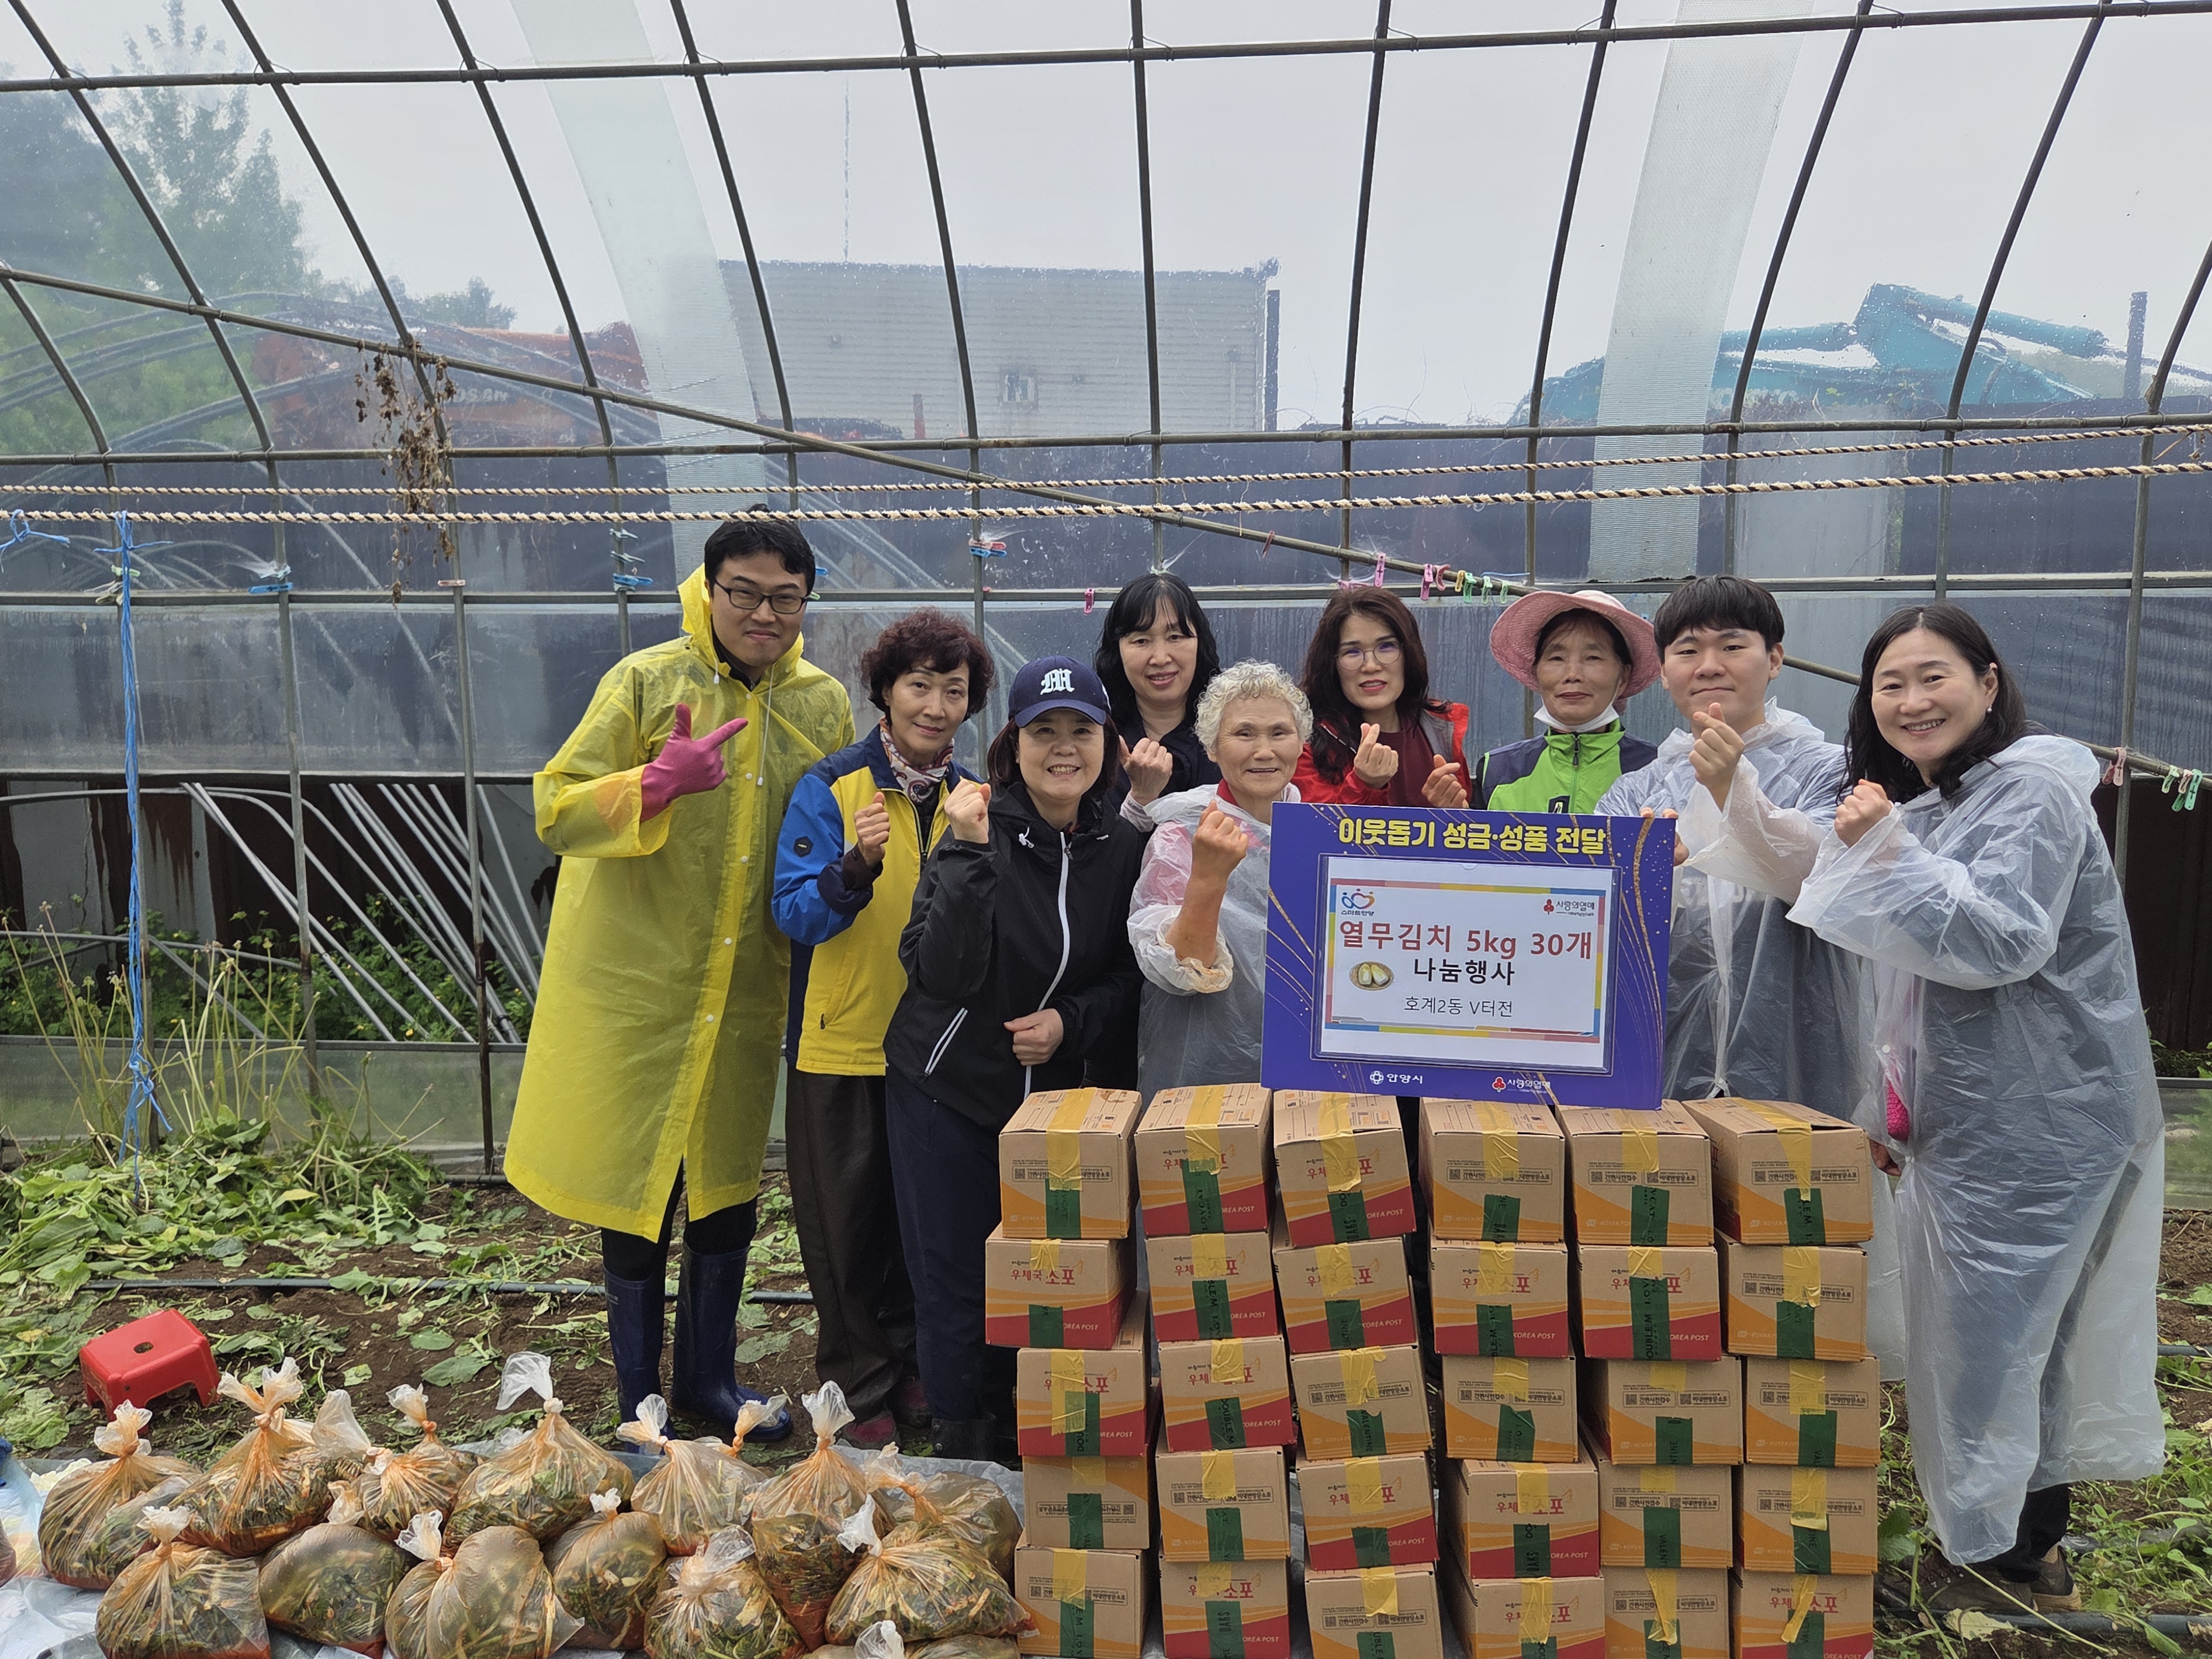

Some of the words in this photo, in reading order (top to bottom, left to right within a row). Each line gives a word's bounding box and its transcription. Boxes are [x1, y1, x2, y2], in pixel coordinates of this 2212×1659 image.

[454, 388, 509, 402] OSAN
[1040, 668, 1074, 695] M
[1339, 818, 1435, 847] 이웃돕기
[1442, 822, 1548, 854] 성금·성품
[1555, 827, 1606, 855] 전달
[1556, 901, 1594, 911] 사랑의열매
[1339, 921, 1451, 952] 열무김치
[1467, 930, 1516, 959] 5kg
[1530, 931, 1592, 960] 30개
[1413, 957, 1515, 986] 나눔행사
[1404, 997, 1463, 1015] 호계2동
[1469, 1001, 1514, 1018] V터전
[1386, 1073, 1423, 1084] 안양시
[1163, 1159, 1182, 1170] 우체
[1367, 1210, 1385, 1219] OREA
[1493, 1223, 1507, 1239] DAK
[1010, 1269, 1042, 1281] 우체국
[1045, 1269, 1075, 1285] 소포
[1611, 1278, 1630, 1290] 우체
[1667, 1277, 1683, 1293] 포
[1188, 1373, 1209, 1385] 우체
[1359, 1410, 1373, 1452] VALENTINE
[1514, 1424, 1523, 1455] LOVCA
[1223, 1582, 1254, 1598] 소포
[1770, 1597, 1792, 1609] 우체
[1809, 1595, 1839, 1613] 소포
